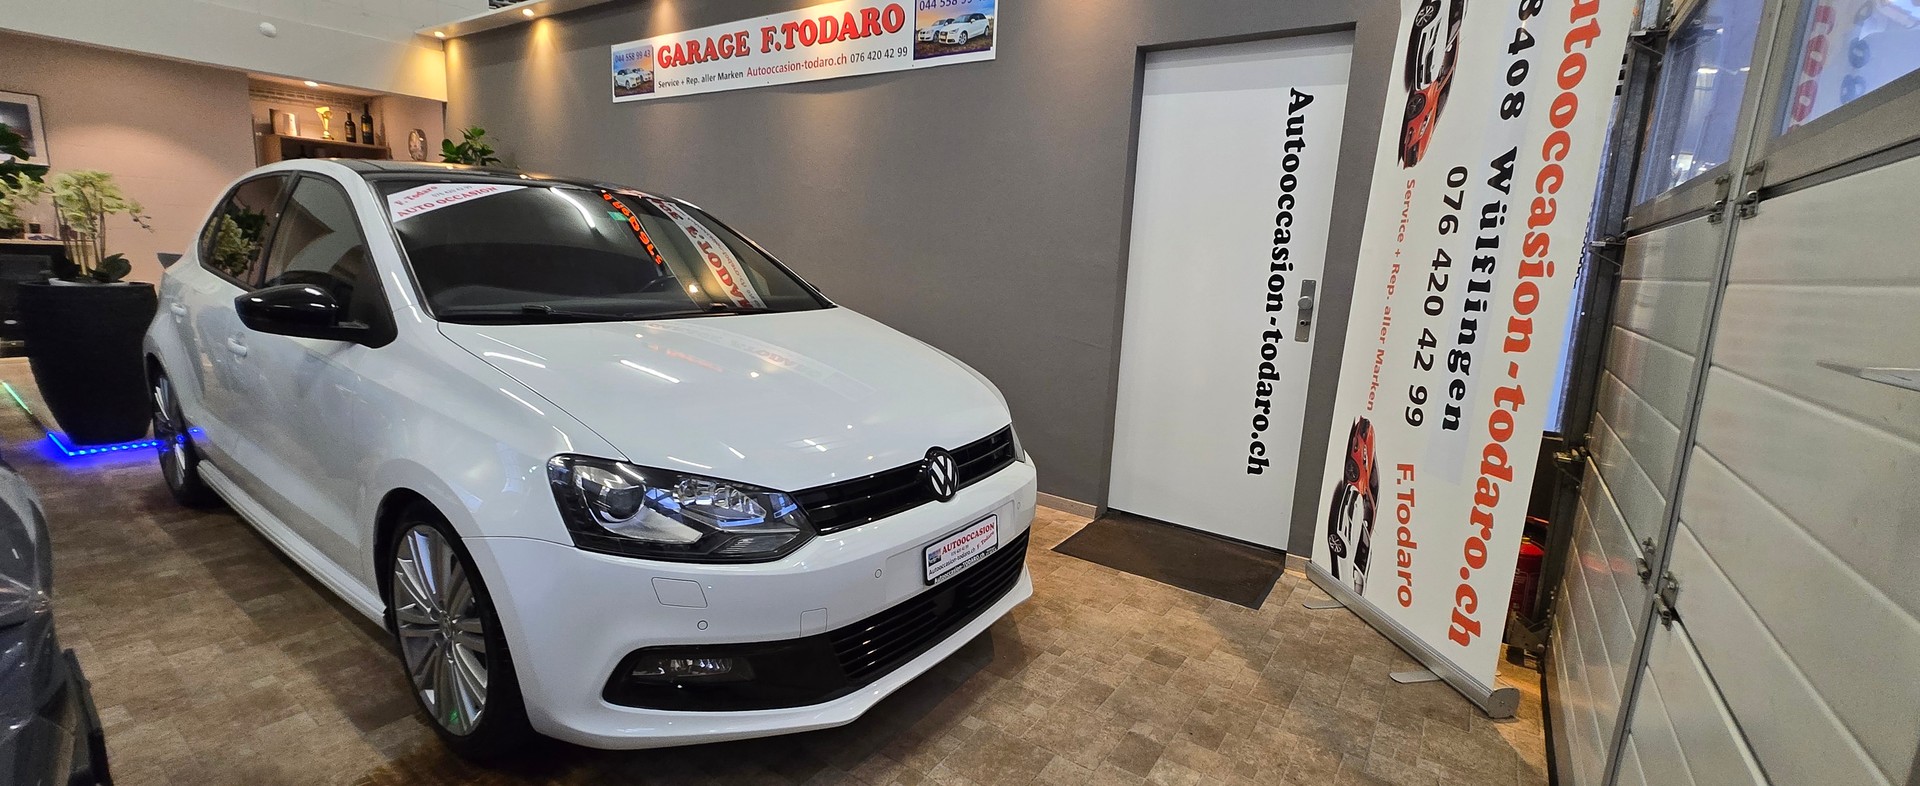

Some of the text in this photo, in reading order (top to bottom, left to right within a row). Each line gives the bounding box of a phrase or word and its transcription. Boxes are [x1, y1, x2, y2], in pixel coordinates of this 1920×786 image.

[614, 50, 651, 64] 044 558 99 43
[657, 3, 906, 69] GARAGE F.TODARO
[658, 80, 680, 89] Service
[686, 76, 700, 87] Rep.
[701, 74, 716, 83] aller
[717, 70, 744, 81] Marken
[746, 53, 847, 77] Autooccasion-todaro.ch
[850, 52, 865, 64] 076
[867, 50, 882, 61] 420
[884, 48, 895, 59] 42
[897, 46, 908, 58] 99
[397, 202, 435, 217] AUTO
[436, 186, 498, 205] OCCASION
[1394, 179, 1416, 244] Service
[1442, 0, 1544, 431] 8408 Wülflingen
[1247, 87, 1315, 475] Autooccasion-todaro.ch
[1384, 264, 1401, 301] Rep.
[1405, 166, 1468, 427] 076 420 42 99
[1375, 306, 1393, 344] aller
[1448, 0, 1601, 647] utooccasion-todaro.ch
[1366, 349, 1385, 411] Marken
[941, 522, 995, 555] AUTOOCCASION
[1396, 463, 1418, 608] F.Todaro
